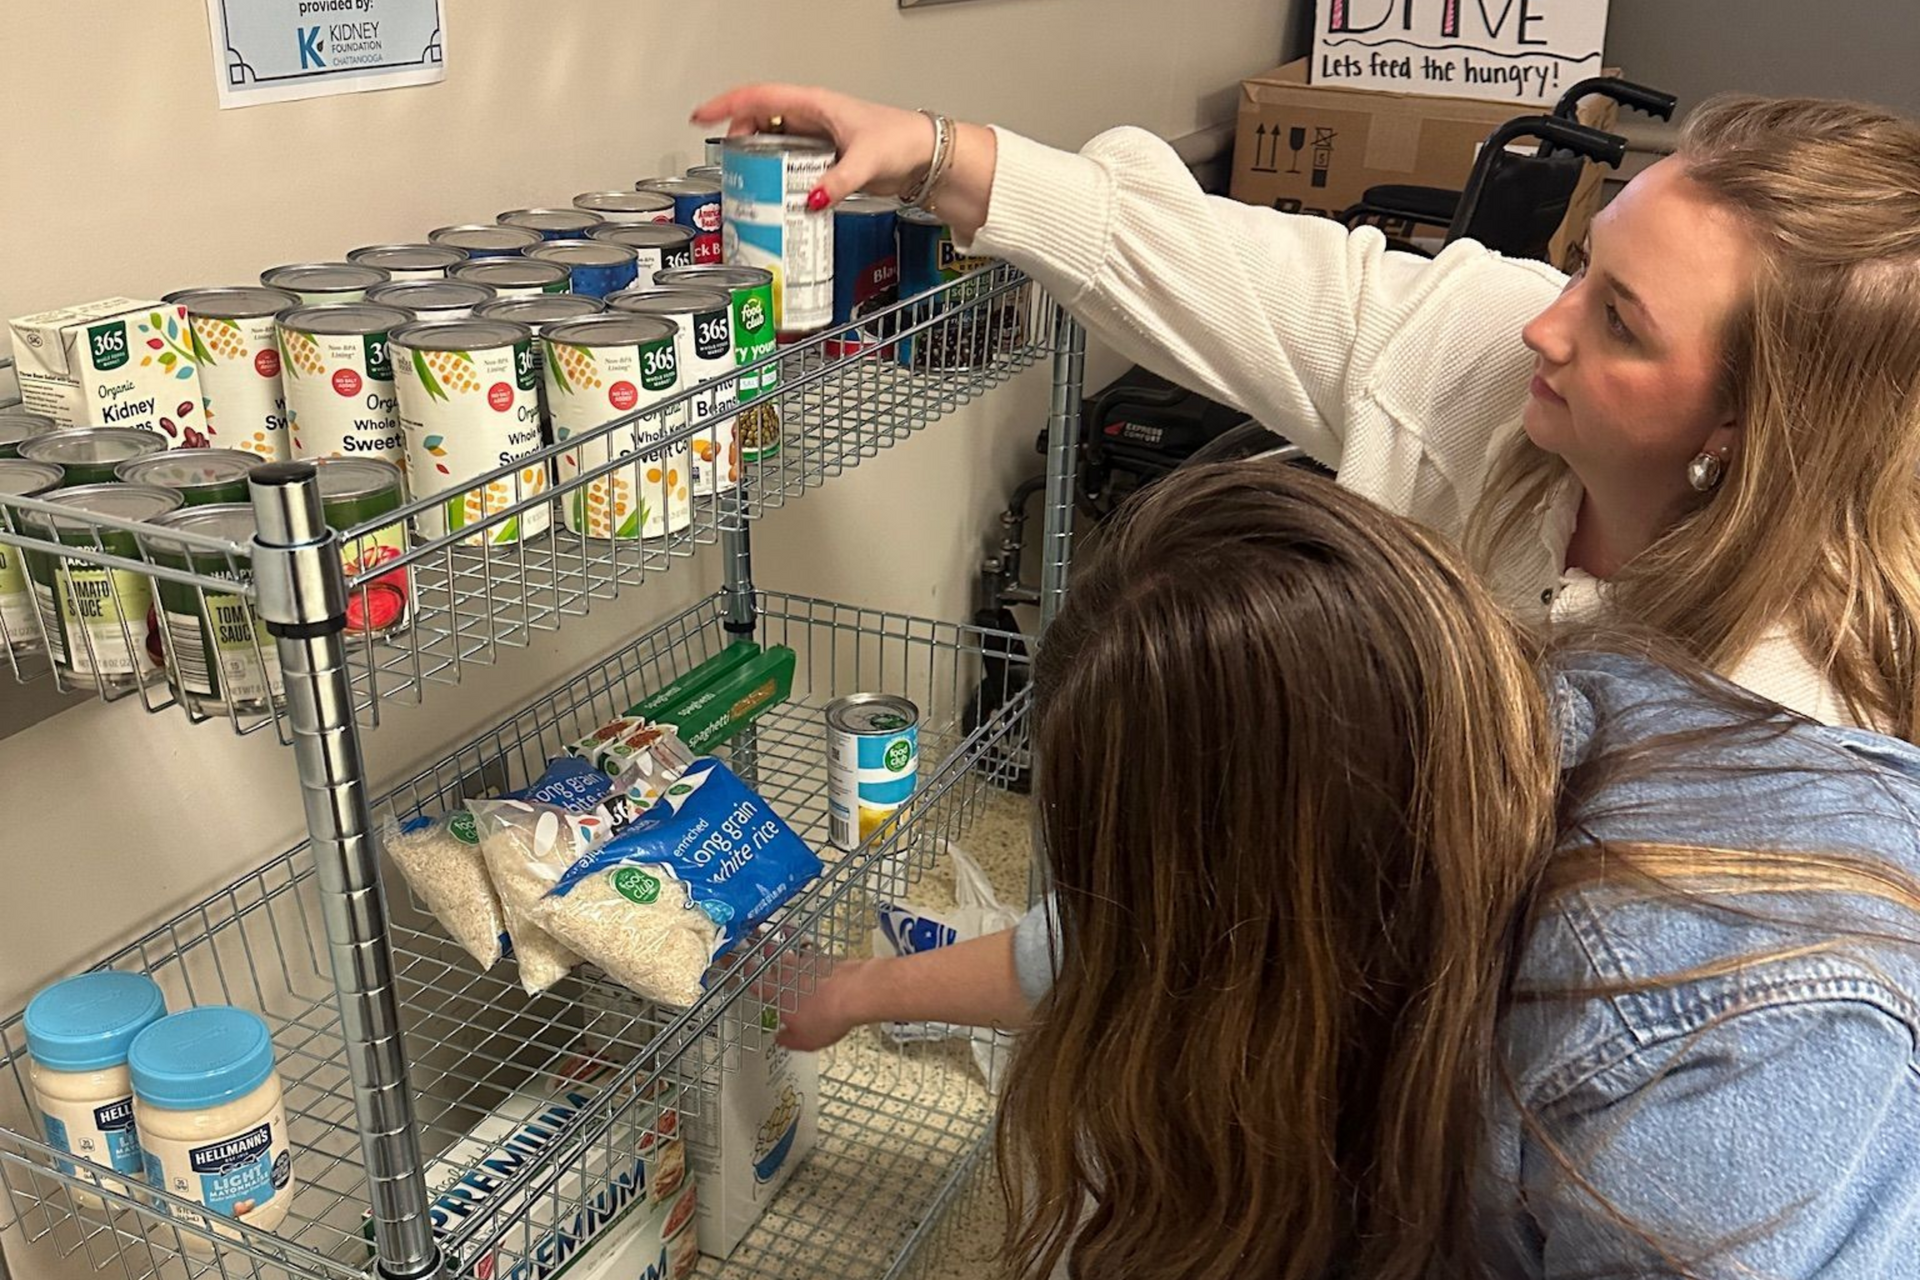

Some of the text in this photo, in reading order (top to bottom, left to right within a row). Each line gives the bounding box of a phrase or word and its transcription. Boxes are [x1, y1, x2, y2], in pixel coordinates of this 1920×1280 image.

[299, 0, 373, 17] provided by:
[329, 21, 379, 41] KIDNEY
[297, 25, 326, 69] K
[332, 41, 382, 53] FOUNDATION
[332, 54, 383, 66] CHATTANOOGA
[1322, 52, 1559, 97] Lets feed the hungry!
[741, 300, 763, 322] food
[746, 313, 765, 330] club
[699, 319, 728, 344] 365
[93, 330, 124, 356] 365
[644, 347, 675, 376] 365
[98, 380, 135, 400] Organic
[102, 397, 155, 424] Kidney
[354, 416, 396, 431] Whole
[343, 433, 402, 452] Sweet
[689, 710, 731, 748] spaghetti
[888, 746, 908, 757] food
[890, 755, 908, 767] club
[565, 773, 605, 793] grain
[673, 817, 710, 858] enriched
[682, 801, 758, 868] long grain
[706, 820, 780, 884] white rice
[618, 871, 646, 890] food
[633, 878, 655, 899] club
[195, 1128, 269, 1165] HELLMANN'S
[209, 1171, 269, 1198] MAYONNAISE
[213, 1164, 263, 1190] LIGHT
